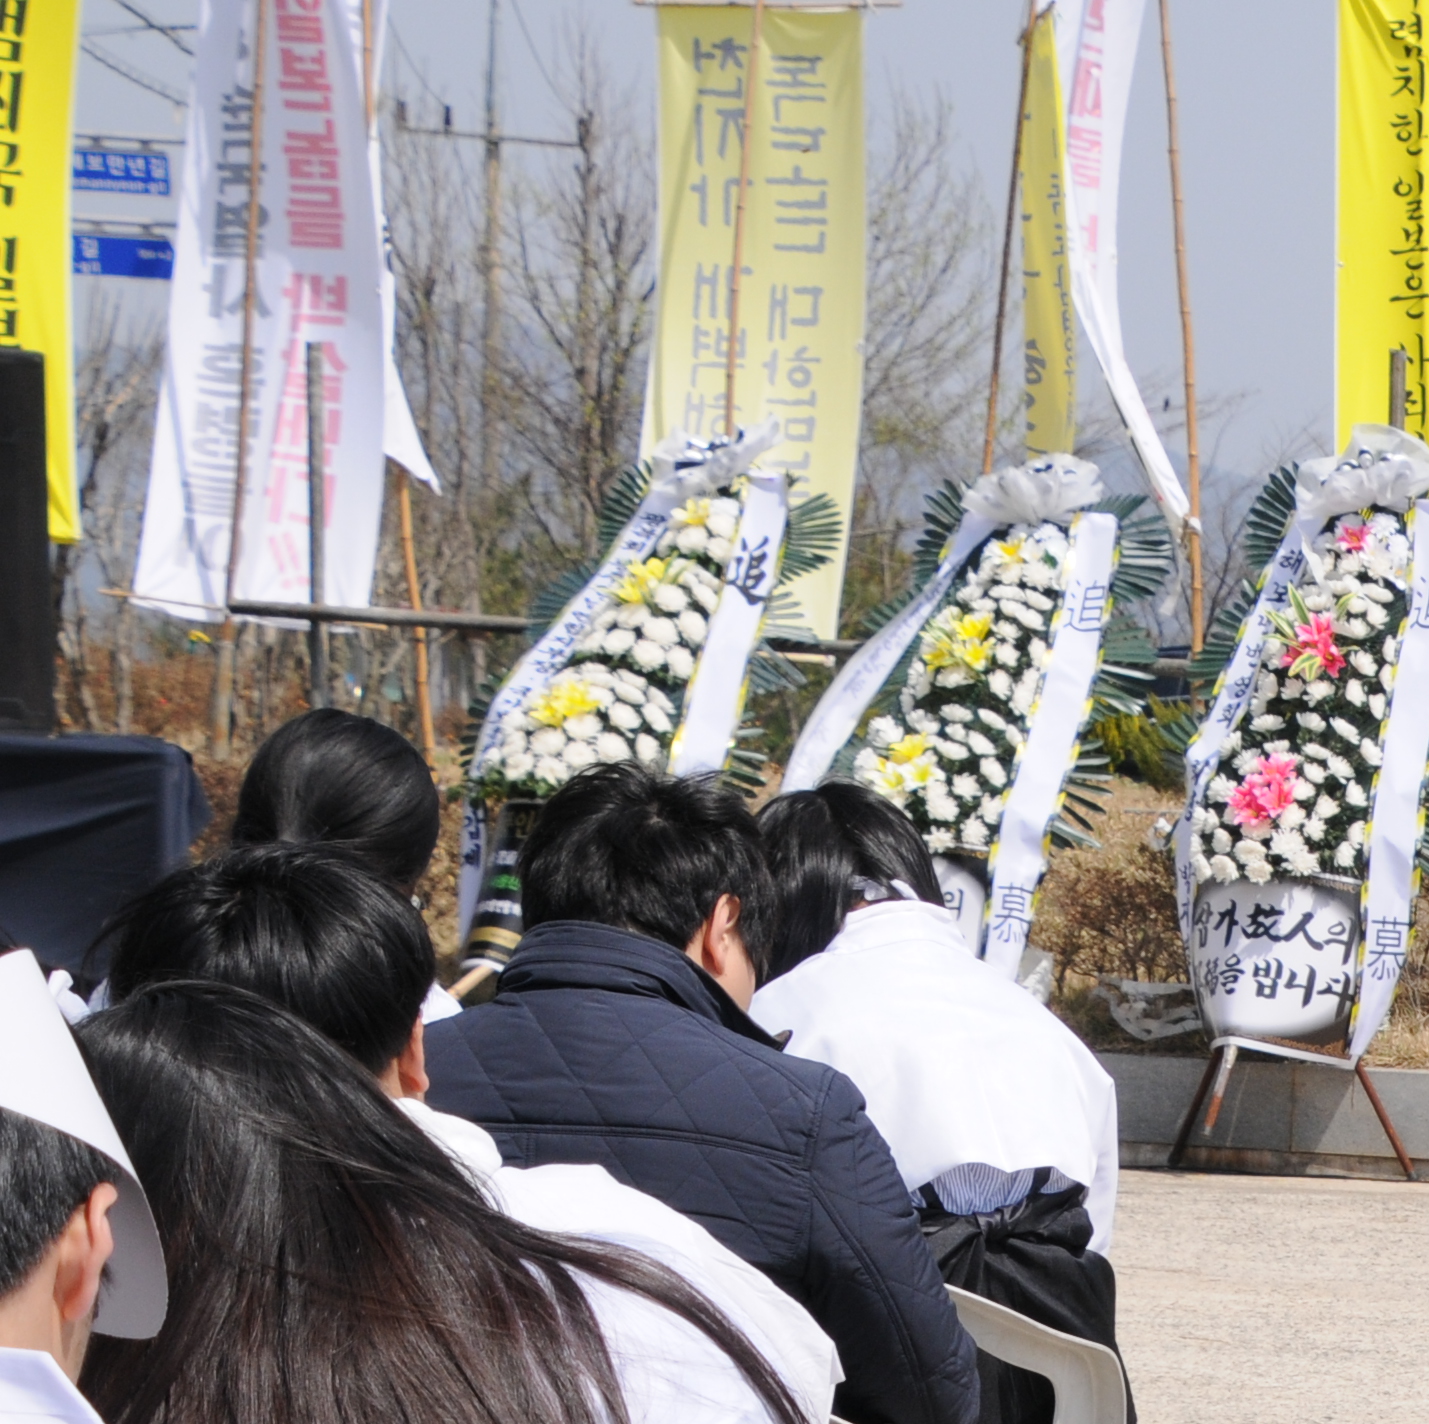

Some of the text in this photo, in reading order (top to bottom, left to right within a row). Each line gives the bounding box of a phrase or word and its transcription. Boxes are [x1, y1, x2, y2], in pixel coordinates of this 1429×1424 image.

[1389, 0, 1429, 157] 렴치한
[1063, 579, 1107, 633] 追
[1367, 916, 1410, 981] 慕
[1252, 956, 1357, 1022] 빕니다
